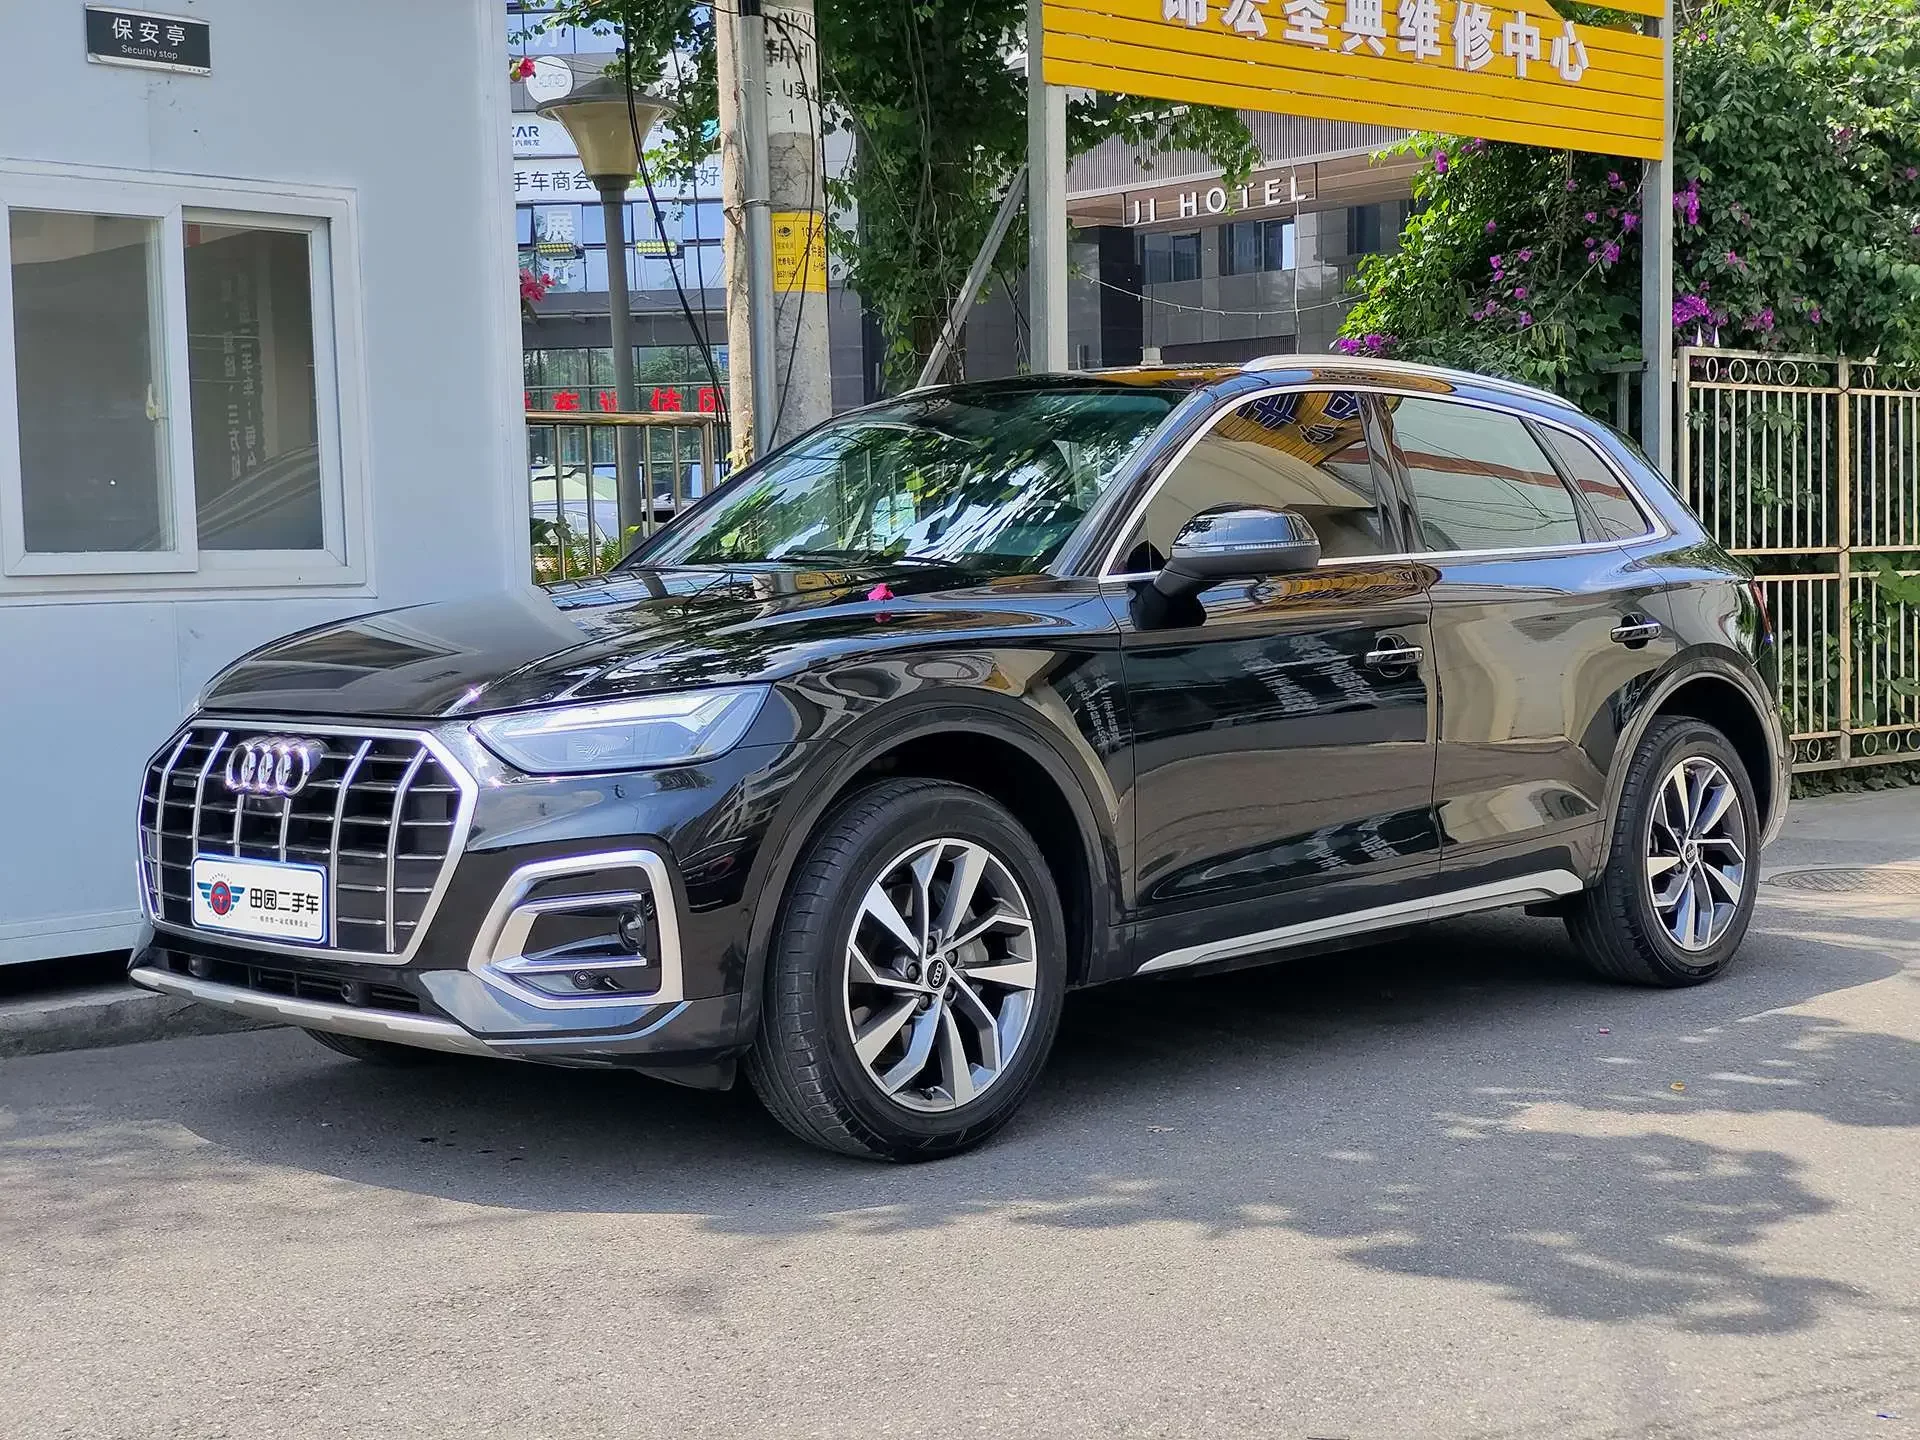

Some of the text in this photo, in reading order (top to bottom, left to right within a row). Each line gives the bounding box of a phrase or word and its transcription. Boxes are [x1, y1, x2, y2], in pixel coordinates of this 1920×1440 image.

[112, 17, 186, 46] 保安亭
[121, 44, 178, 60] Security stop
[1133, 176, 1307, 225] JI HOTEL
[250, 887, 319, 915] 田园二手车
